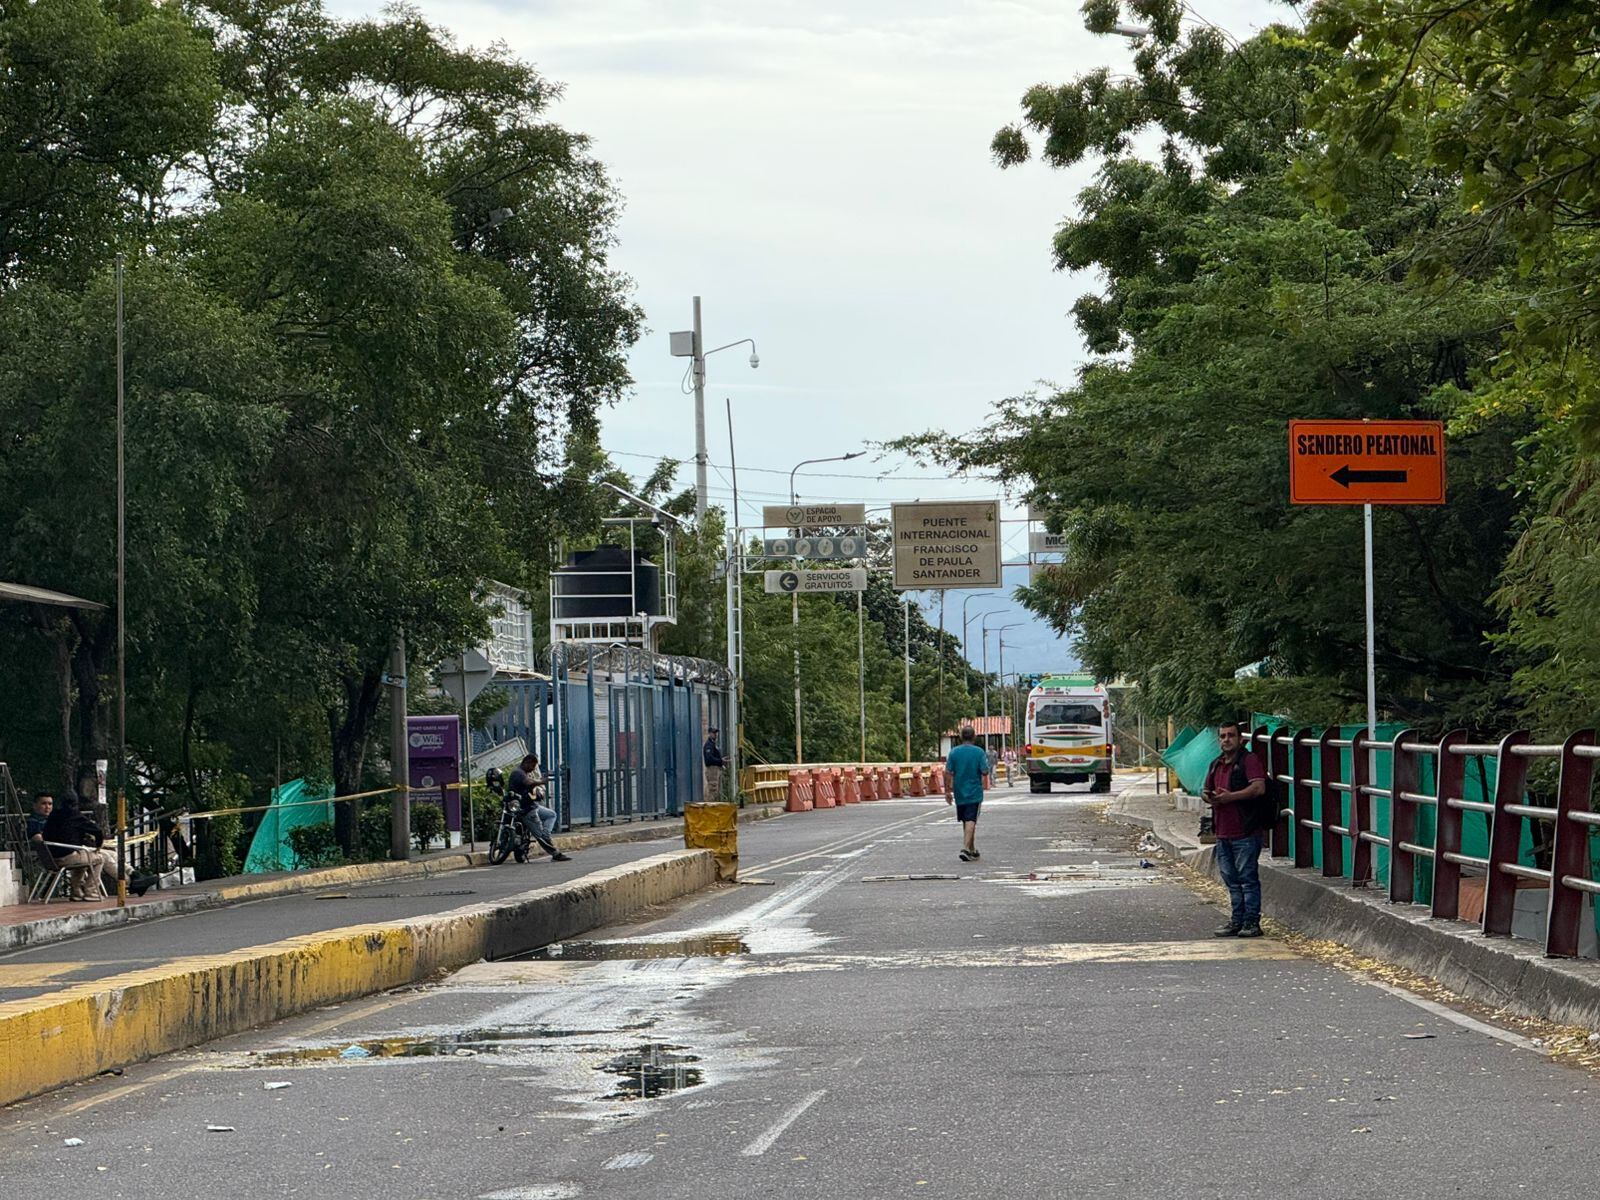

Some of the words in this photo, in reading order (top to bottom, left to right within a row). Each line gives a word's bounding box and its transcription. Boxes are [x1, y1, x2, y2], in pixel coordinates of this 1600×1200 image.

[1297, 434, 1363, 456] SENDERO
[1366, 434, 1437, 456] PEATONAL
[806, 507, 837, 515] ESPACIO
[817, 514, 842, 523] APOYO
[922, 517, 968, 527] PUENTE
[900, 529, 990, 540] INTERNACIONAL
[913, 544, 978, 554] FRANCISCO
[919, 557, 934, 566] DE
[937, 556, 973, 566] PAULA
[806, 572, 851, 581] SERVICIOS
[912, 568, 981, 579] SANTANDER
[804, 581, 853, 590] GRATUITOS
